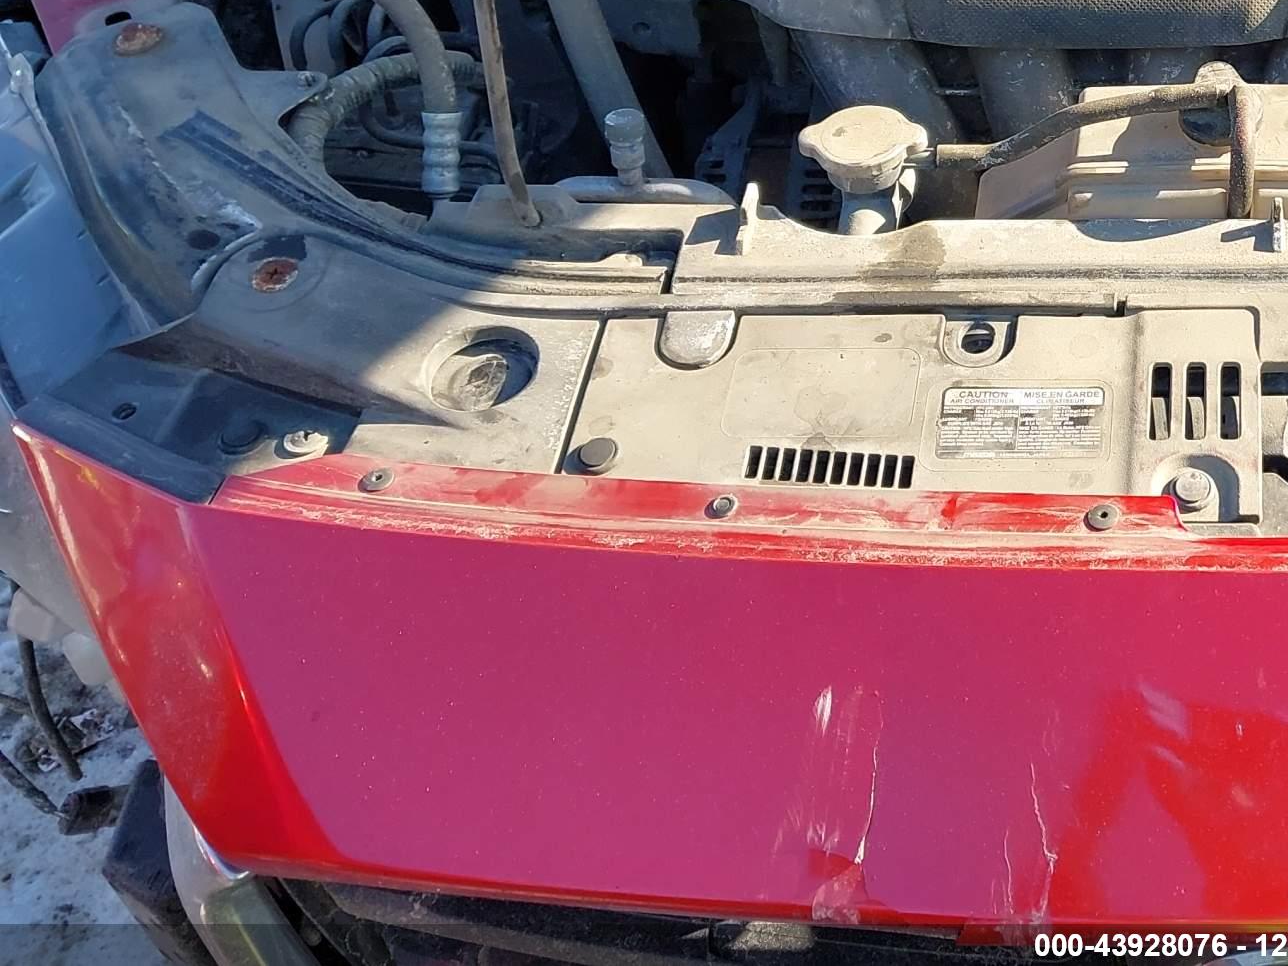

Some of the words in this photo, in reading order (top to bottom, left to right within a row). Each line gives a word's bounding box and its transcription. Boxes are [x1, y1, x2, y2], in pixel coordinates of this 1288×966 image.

[959, 390, 1009, 399] CAUTION
[1023, 391, 1047, 399] MISE
[1048, 391, 1063, 399] EN
[1065, 390, 1100, 398] GARDE
